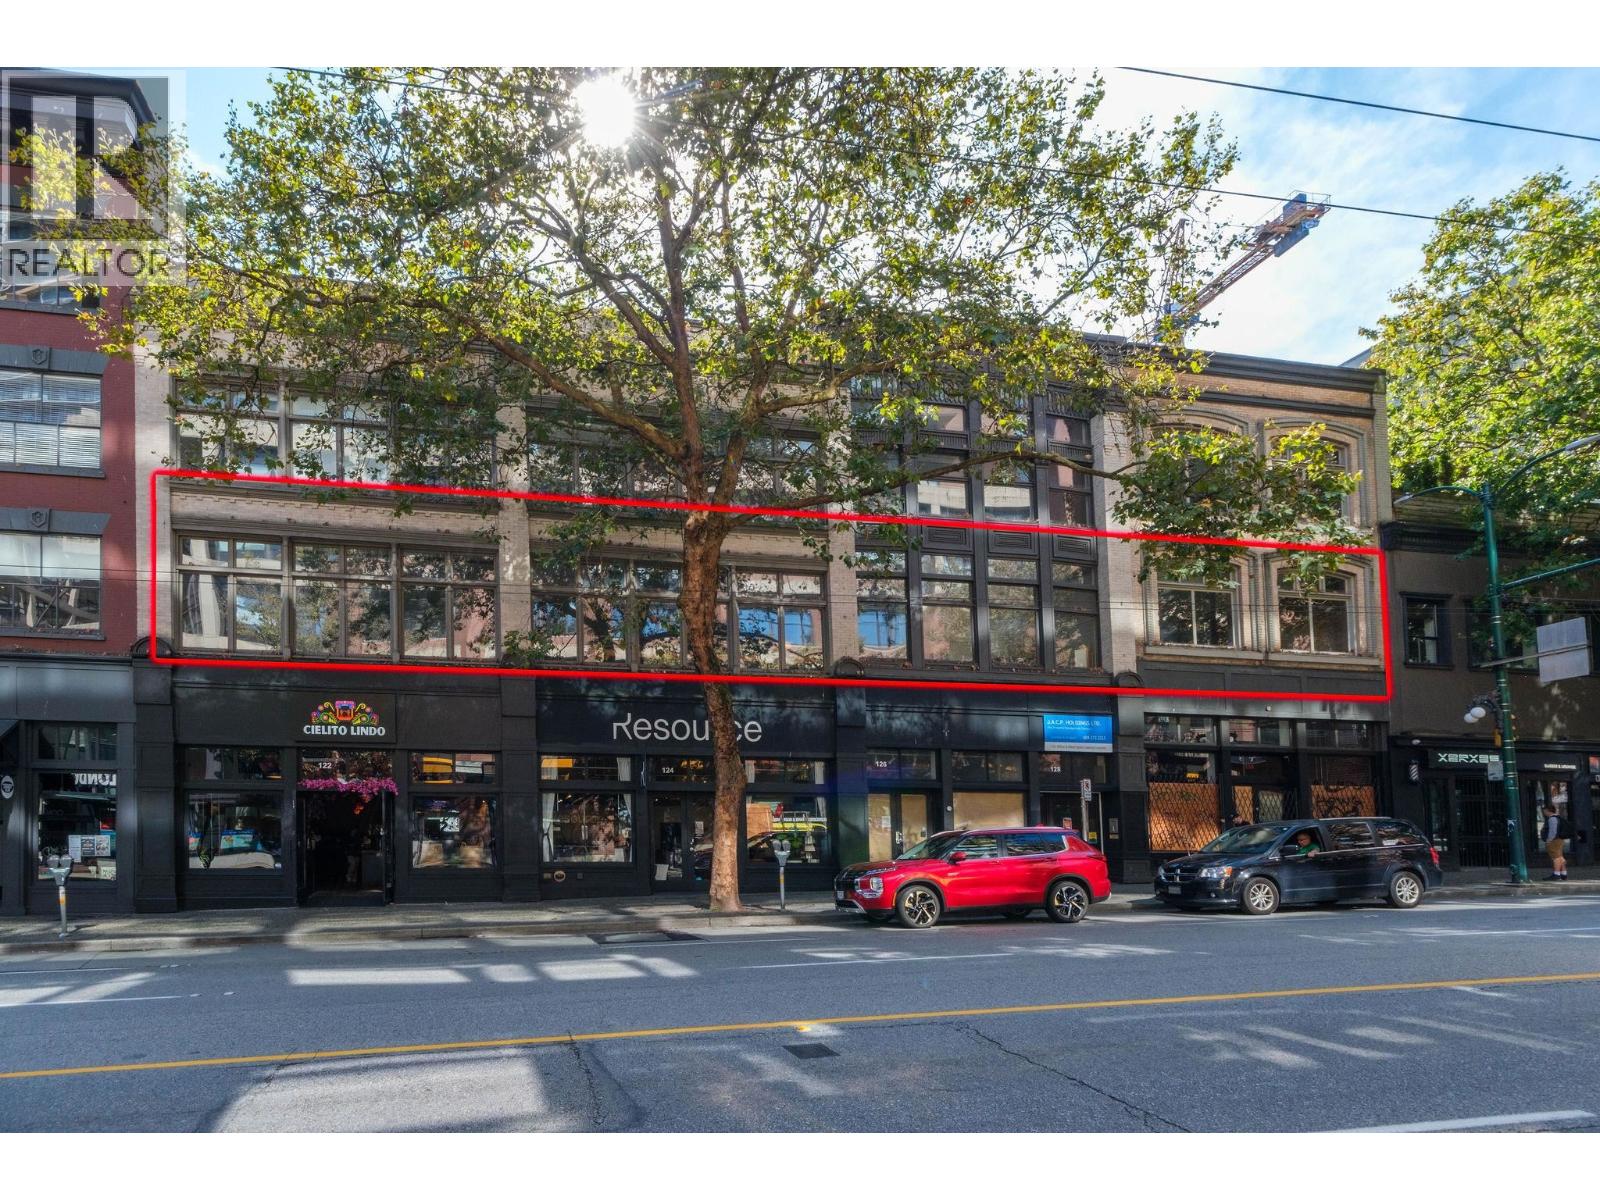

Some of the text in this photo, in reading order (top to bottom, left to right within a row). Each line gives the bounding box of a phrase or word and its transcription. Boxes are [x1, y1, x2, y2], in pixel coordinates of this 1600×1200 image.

[303, 725, 386, 736] CIELITO LINDO
[613, 712, 763, 743] Resoue
